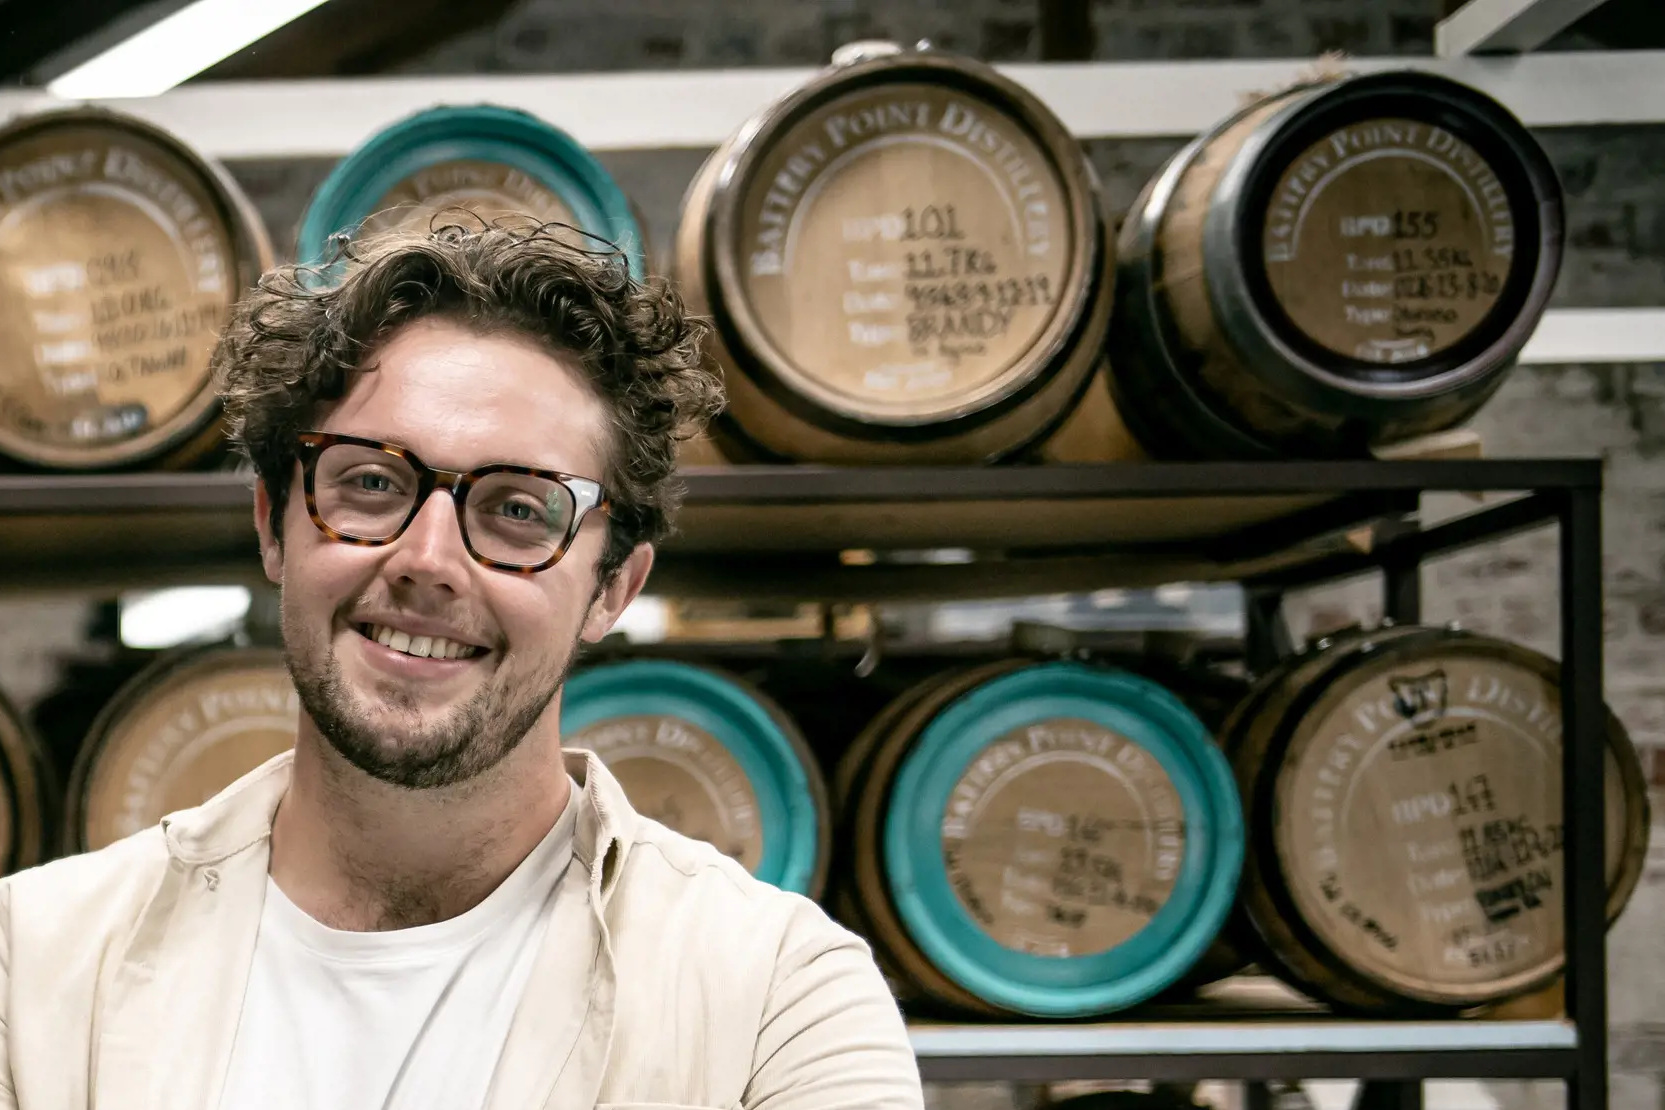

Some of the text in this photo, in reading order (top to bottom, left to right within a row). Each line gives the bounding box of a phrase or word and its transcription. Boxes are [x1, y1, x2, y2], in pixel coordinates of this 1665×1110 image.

[1329, 124, 1422, 161] POINT
[751, 101, 1053, 279] BATTERY POINT DISTILLERY
[901, 204, 966, 241] 101
[1392, 209, 1440, 241] 155
